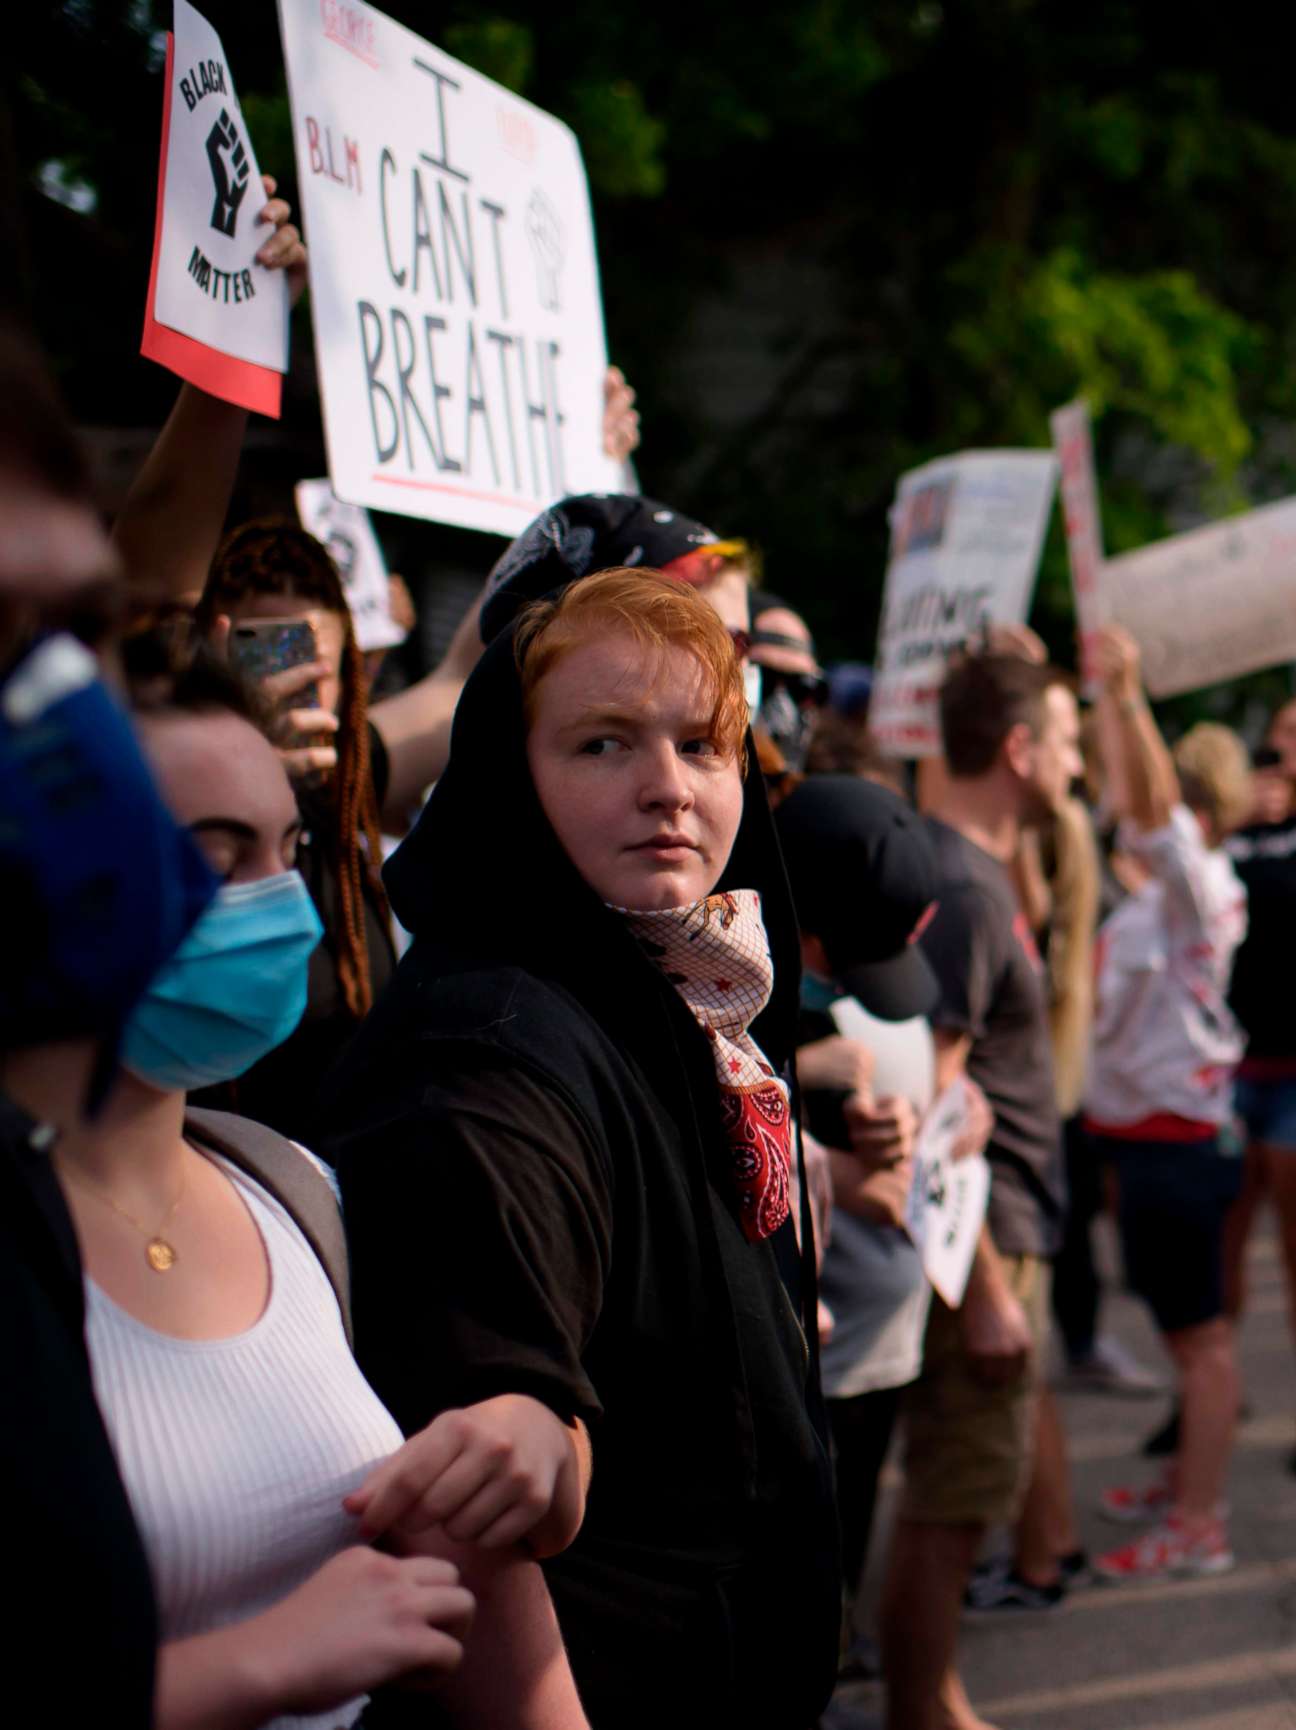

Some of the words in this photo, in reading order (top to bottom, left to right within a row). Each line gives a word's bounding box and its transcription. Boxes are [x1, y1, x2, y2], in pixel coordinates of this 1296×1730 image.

[179, 59, 228, 113] BLACK
[411, 57, 471, 183] I
[187, 246, 256, 304] MATTER
